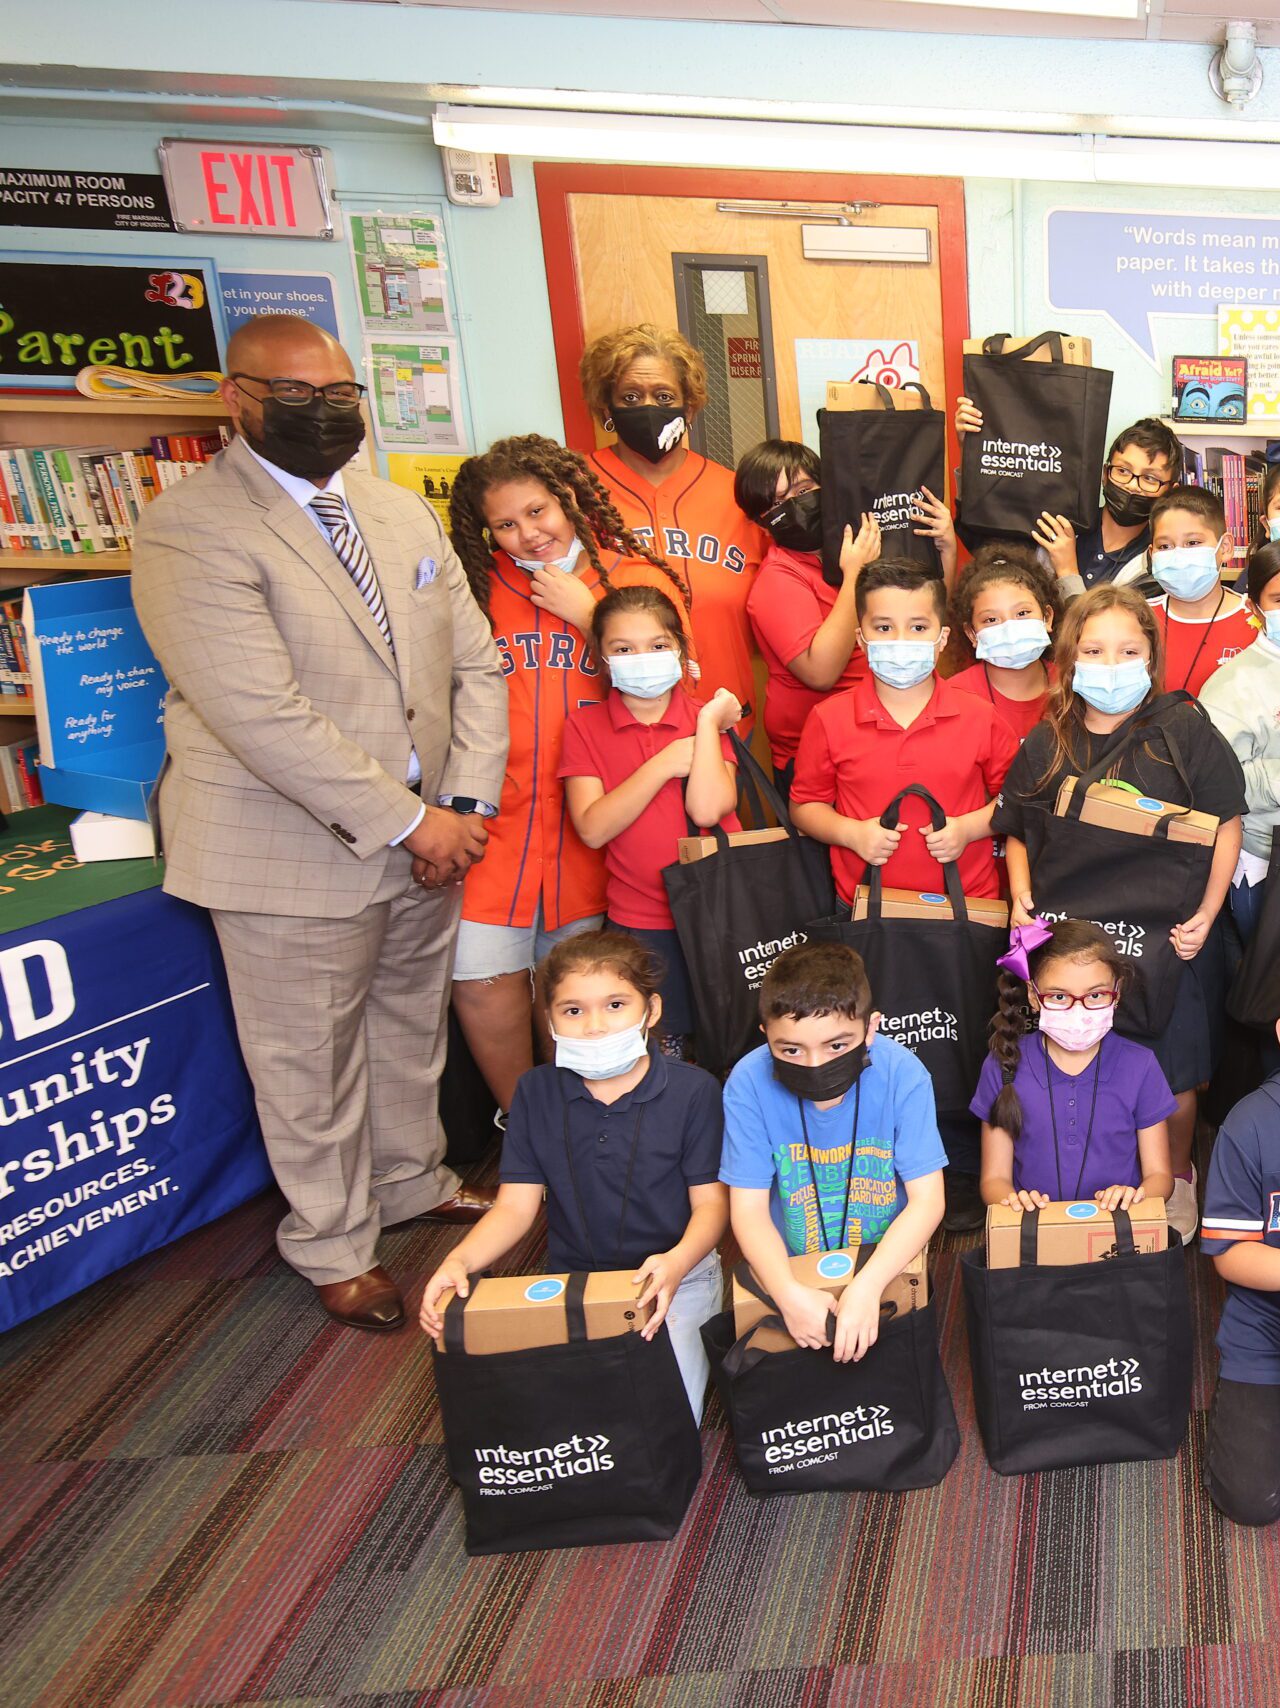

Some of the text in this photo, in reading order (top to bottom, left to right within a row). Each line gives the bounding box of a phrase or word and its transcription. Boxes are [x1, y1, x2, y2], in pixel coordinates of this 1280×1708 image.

[75, 176, 126, 190] ROOM
[201, 152, 297, 227] EXIT
[0, 190, 155, 209] ACITY 47 PERSONS
[1124, 226, 1196, 246] “Words
[1203, 233, 1255, 248] mean
[1116, 255, 1177, 273] paper.
[1185, 255, 1198, 272] It
[1203, 256, 1255, 274] takes
[238, 289, 327, 302] in your shoes.
[1151, 280, 1192, 298] with
[1198, 282, 1267, 304] deeper
[234, 306, 256, 316] you
[731, 366, 757, 377] RISER
[1179, 364, 1222, 377] Afraid
[982, 438, 1048, 457] internet
[981, 454, 1062, 473] essentials
[998, 470, 1024, 478] COMCAST
[39, 627, 124, 646] Ready to change
[56, 639, 108, 655] the world.
[80, 667, 155, 686] Ready to share
[96, 679, 149, 697] my voice.
[65, 714, 97, 728] Ready
[68, 725, 114, 743] anything.
[0, 1157, 156, 1244] RESOURCES.
[789, 1184, 816, 1206] FOCUS
[848, 1190, 871, 1204] HARD
[0, 1176, 179, 1278] ACHIEVEMENT.
[1019, 1357, 1119, 1387] internet
[1021, 1374, 1143, 1401] essentials
[1023, 1401, 1089, 1411] FROM COMCAST
[761, 1404, 869, 1444] internet
[764, 1416, 895, 1464] essentials
[475, 1434, 588, 1466] internet
[479, 1451, 615, 1486] essentials
[768, 1451, 839, 1475] FROM COMCAST
[480, 1483, 553, 1496] FROM COMCAST
